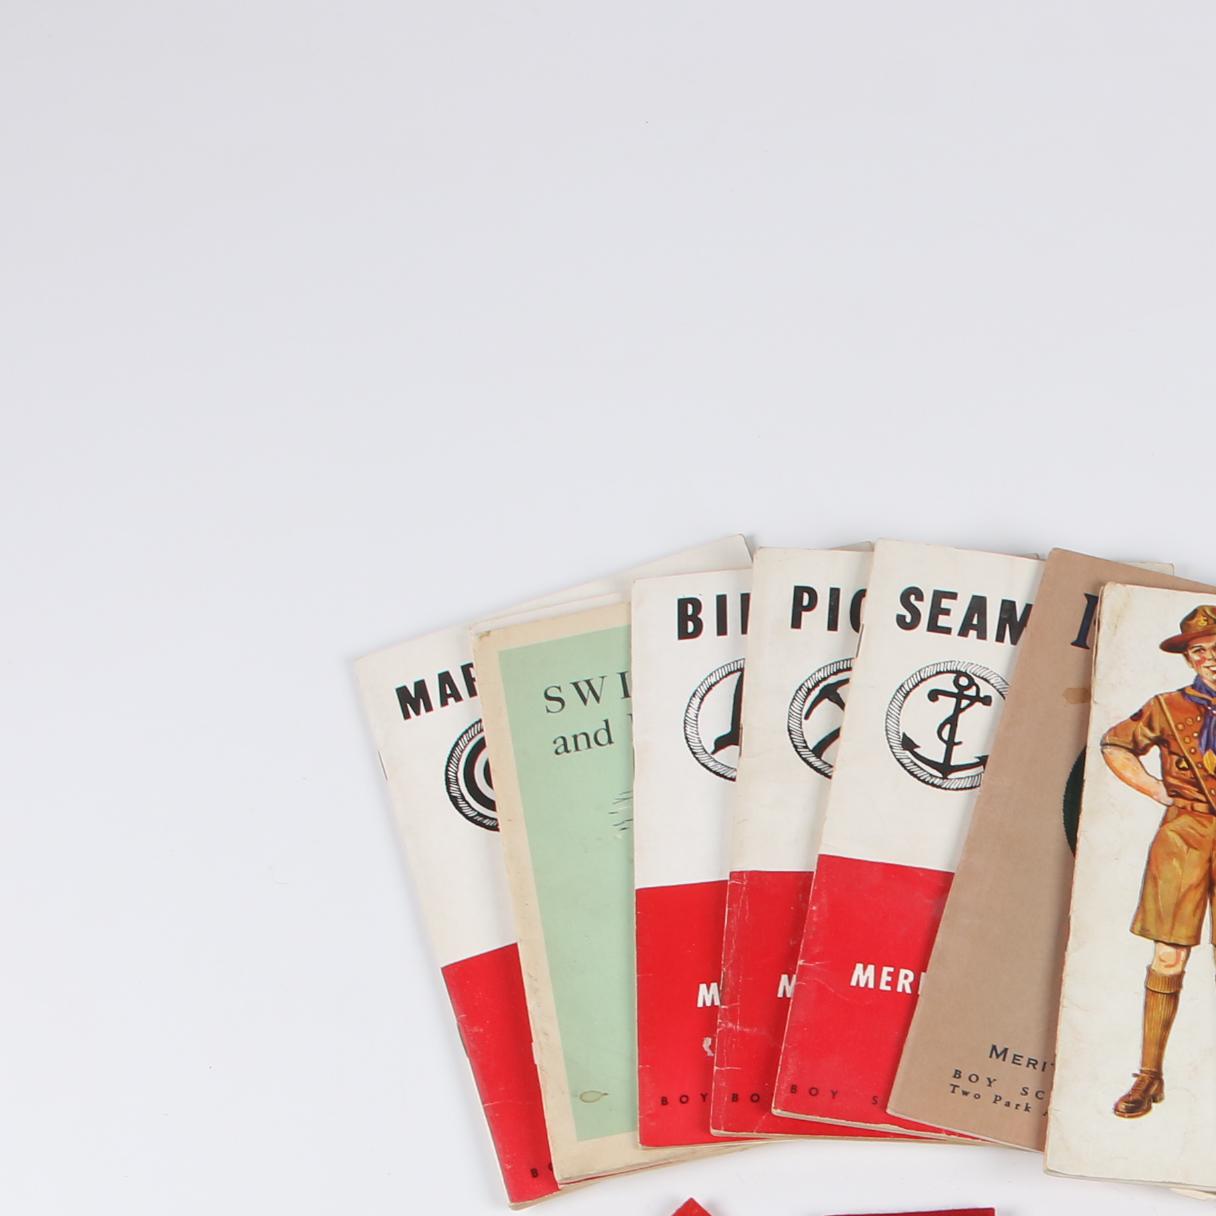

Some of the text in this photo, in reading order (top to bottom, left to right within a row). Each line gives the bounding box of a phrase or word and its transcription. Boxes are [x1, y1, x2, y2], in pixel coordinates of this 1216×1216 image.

[552, 718, 615, 756] and
[952, 1069, 996, 1088] BOY
[789, 1084, 838, 1099] BOY
[949, 1083, 1032, 1112] Two Park
